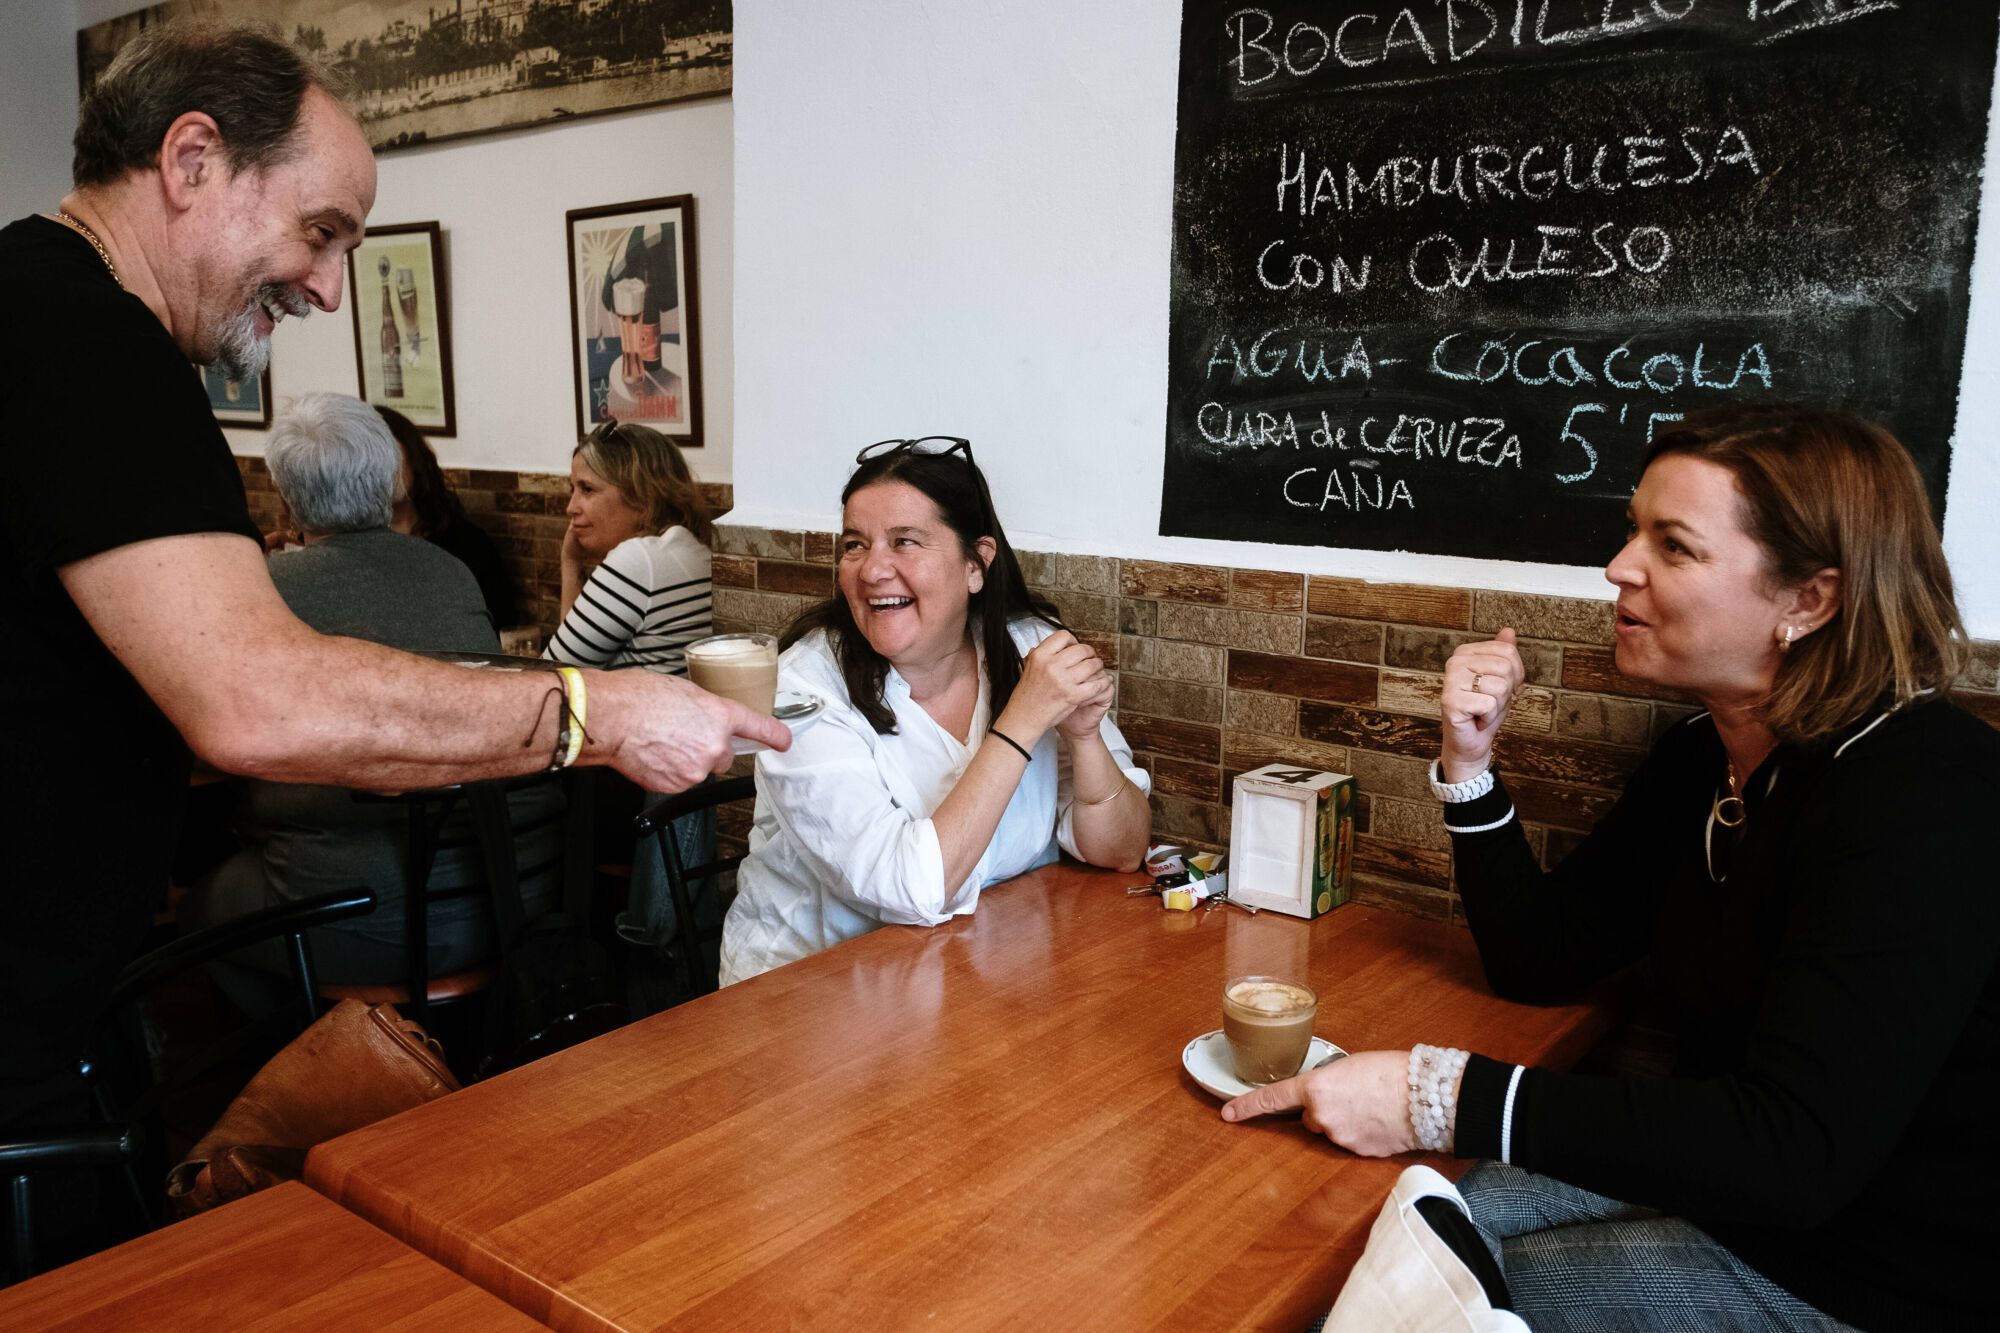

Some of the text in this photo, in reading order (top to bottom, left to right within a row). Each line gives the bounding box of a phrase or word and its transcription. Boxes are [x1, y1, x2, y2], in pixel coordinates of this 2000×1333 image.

[1277, 126, 1761, 216] HAMBURGUESA
[1257, 221, 1672, 294] CON QUESO
[1197, 402, 1523, 468] CLARA de CERVEZA
[1262, 770, 1326, 784] 4
